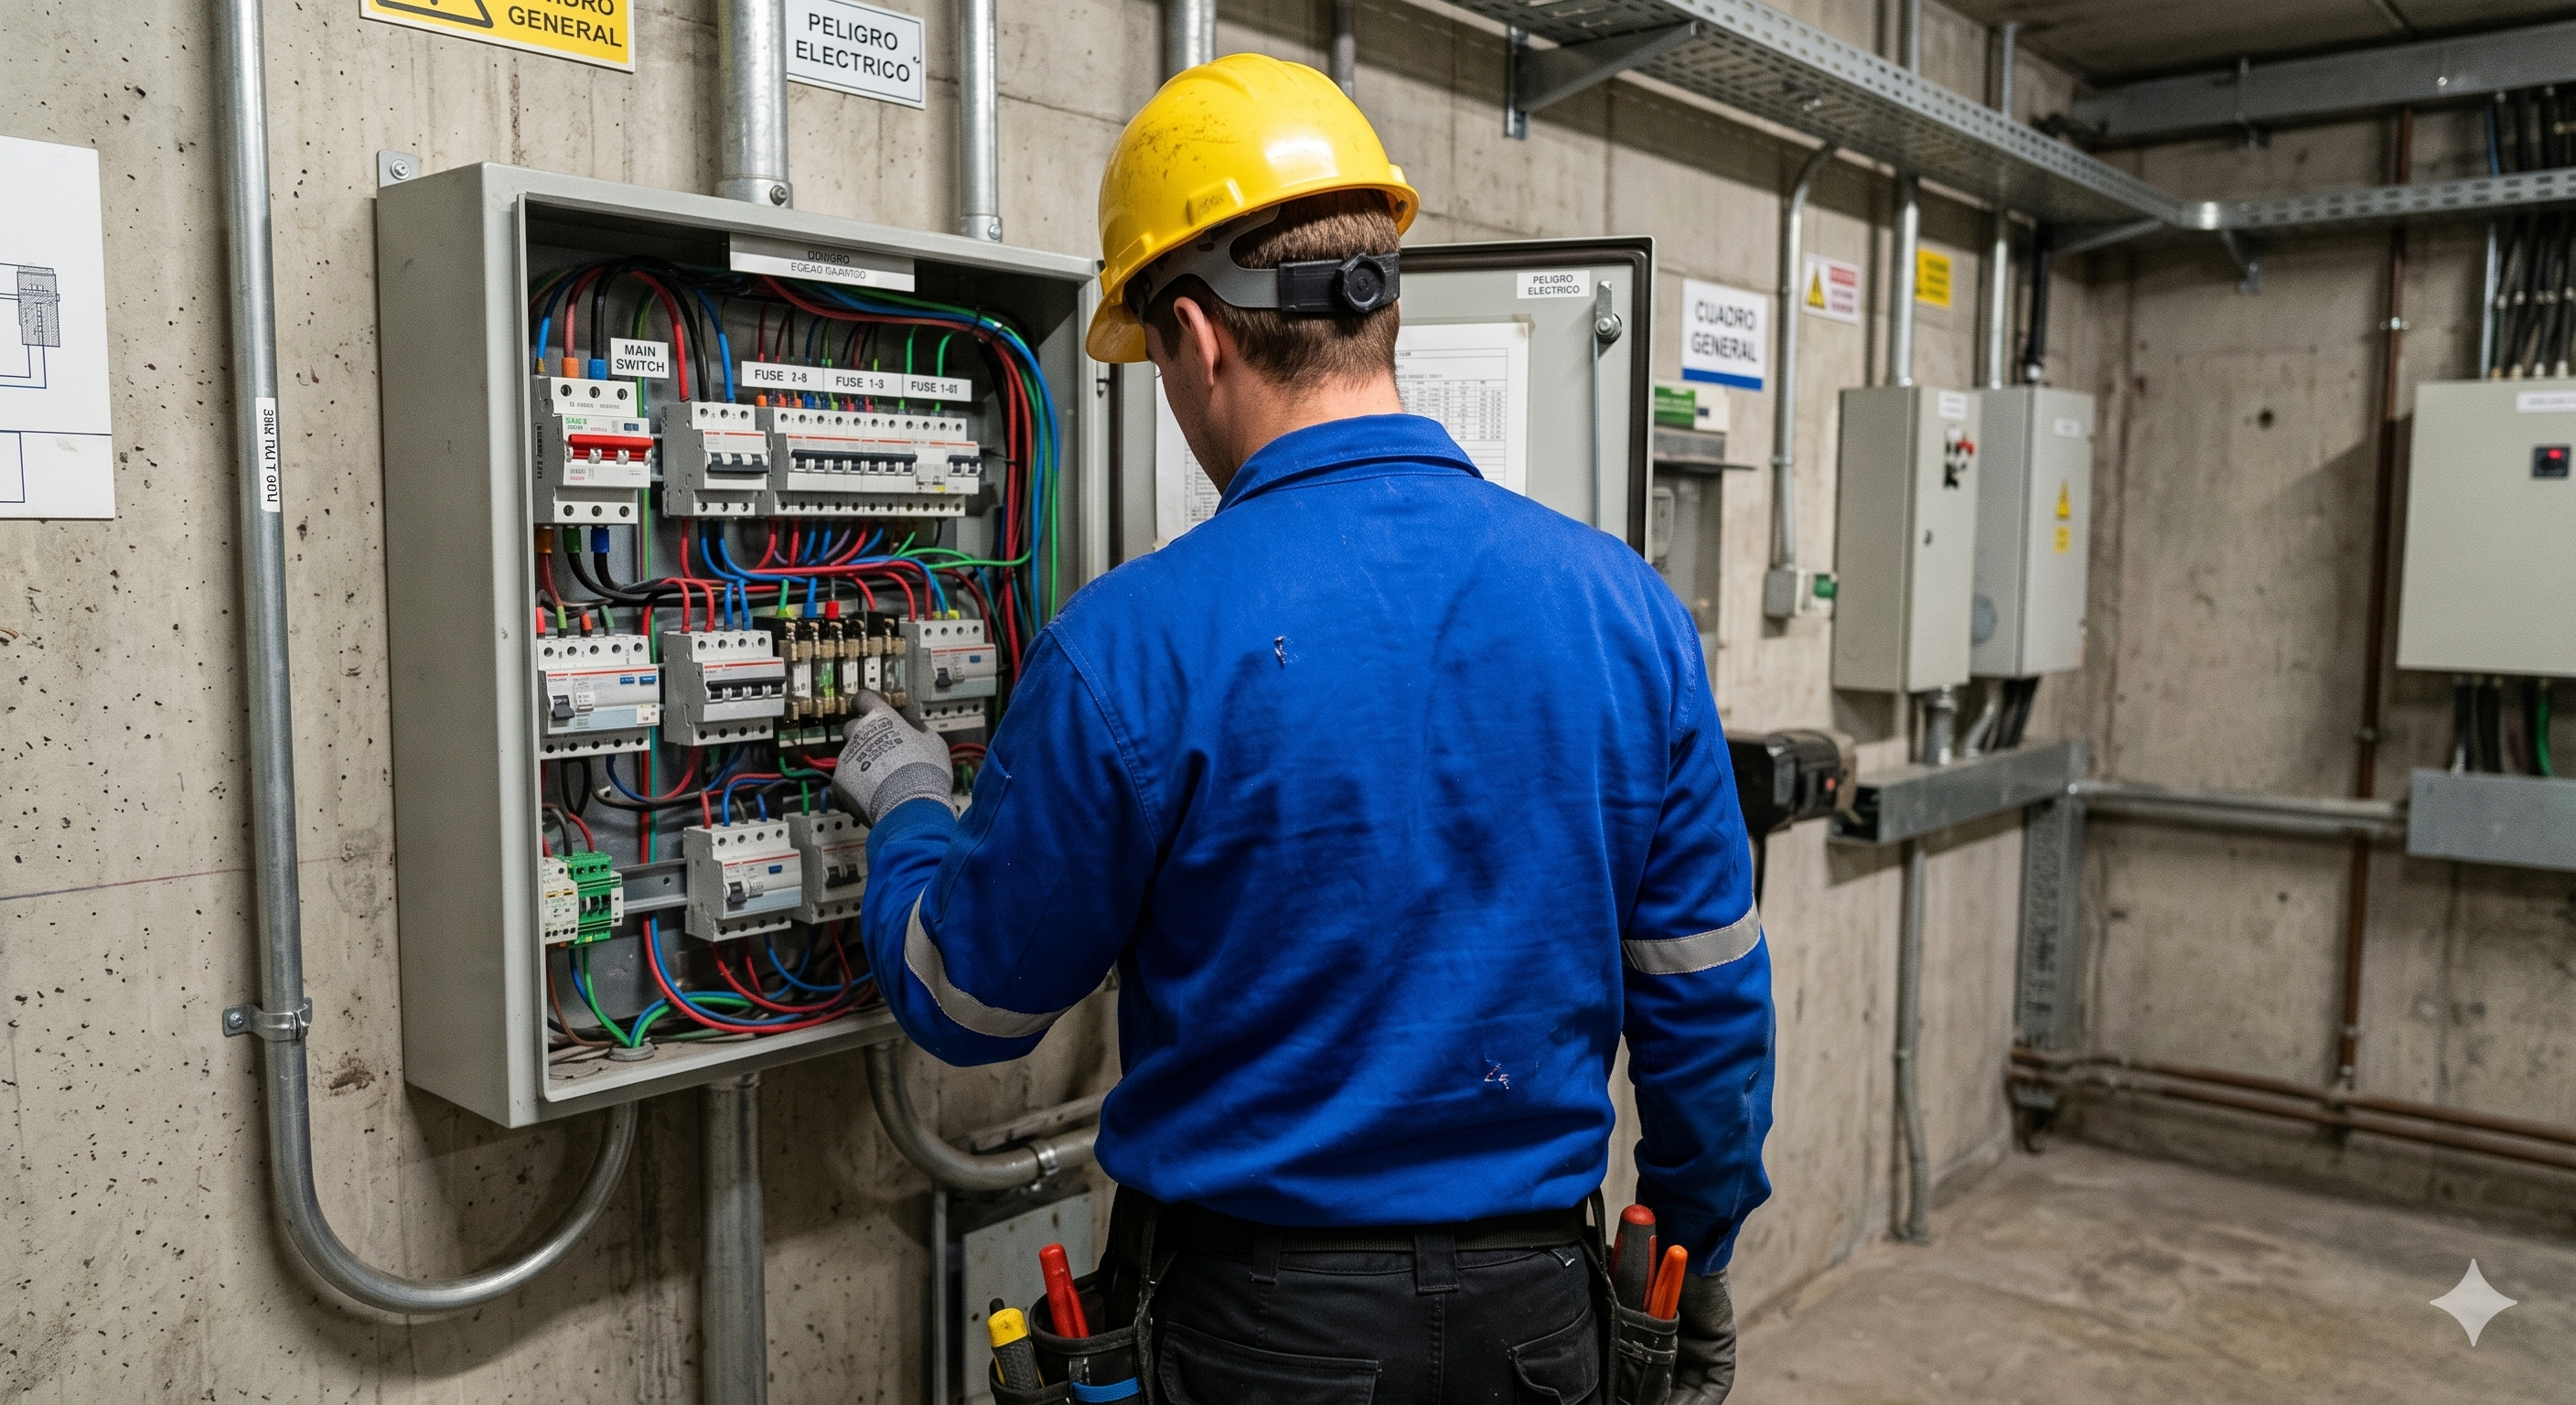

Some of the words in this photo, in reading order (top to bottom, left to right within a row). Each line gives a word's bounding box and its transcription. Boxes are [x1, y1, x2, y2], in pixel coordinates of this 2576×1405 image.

[508, 5, 622, 48] GENERAL
[809, 12, 898, 51] PELIGRO
[796, 39, 910, 82] ELECTRICO
[1533, 274, 1573, 284] PELIGRO
[1528, 284, 1581, 295] ELECTRICO
[1695, 300, 1757, 330] CUADRO
[625, 344, 656, 357] MAIN
[1690, 331, 1758, 362] GENERAL
[616, 358, 665, 373] SWITCH
[754, 369, 784, 382] FUSE
[791, 371, 808, 383] 2-8
[836, 376, 864, 389] FUSE
[869, 379, 885, 390] 1-3
[911, 381, 937, 393] FUSE
